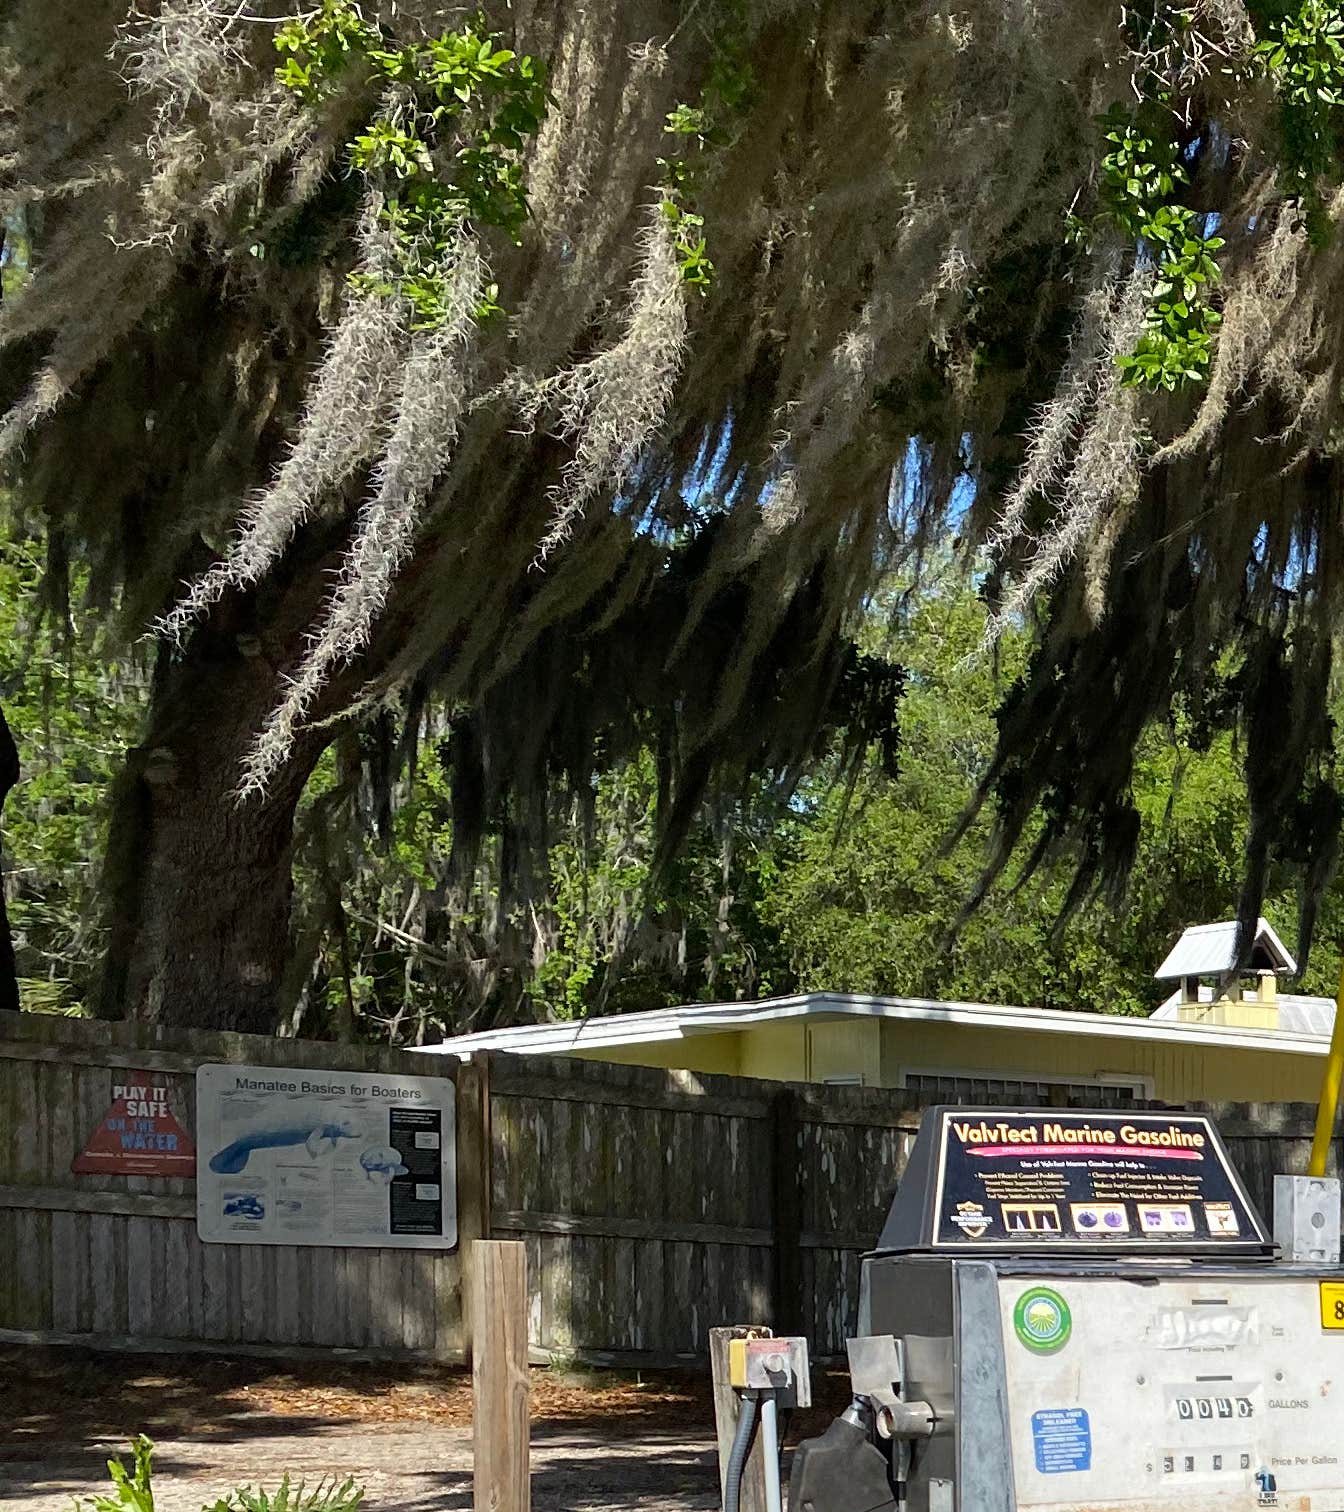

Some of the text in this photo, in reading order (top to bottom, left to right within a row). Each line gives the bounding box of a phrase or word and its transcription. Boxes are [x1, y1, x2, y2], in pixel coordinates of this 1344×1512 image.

[113, 1085, 167, 1101] PLAY IT
[236, 1078, 422, 1099] Manatee Basics for Boaters
[126, 1100, 169, 1118] SAFE
[107, 1119, 156, 1132] ON THE
[953, 1121, 1205, 1147] ValvTect Marine Gasoline
[121, 1134, 178, 1151] WATER
[1268, 1400, 1310, 1409] GALLONS
[1271, 1456, 1338, 1466] Price Per Gallon
